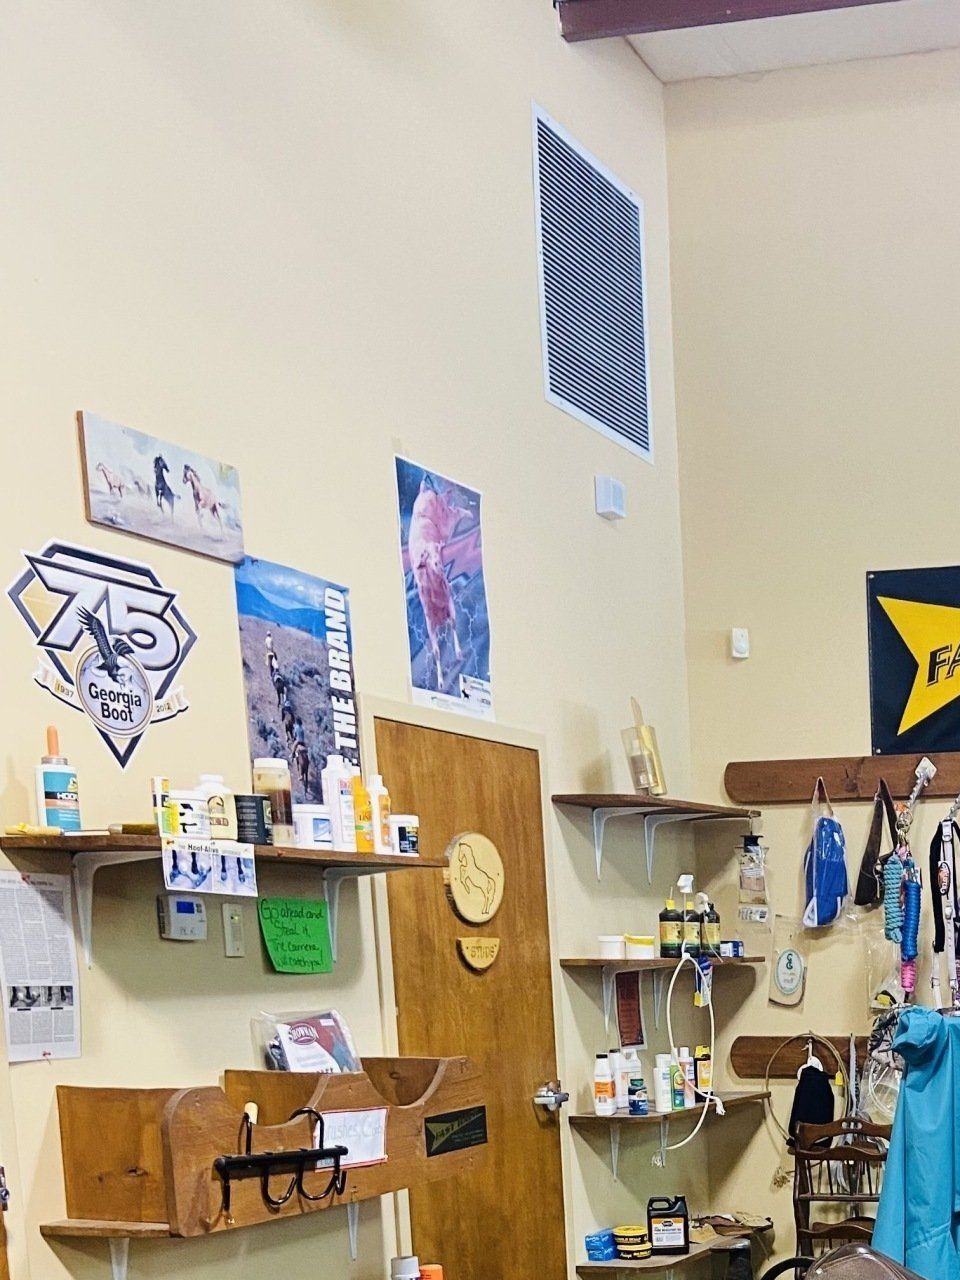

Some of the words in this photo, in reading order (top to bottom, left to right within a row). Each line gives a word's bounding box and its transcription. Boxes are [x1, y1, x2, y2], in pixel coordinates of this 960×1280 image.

[25, 553, 180, 672] 75
[324, 587, 351, 692] BRAND
[88, 682, 142, 709] Georgia
[101, 702, 134, 723] Boot
[333, 696, 356, 750] THE
[261, 899, 279, 922] Go
[280, 903, 304, 919] ahead
